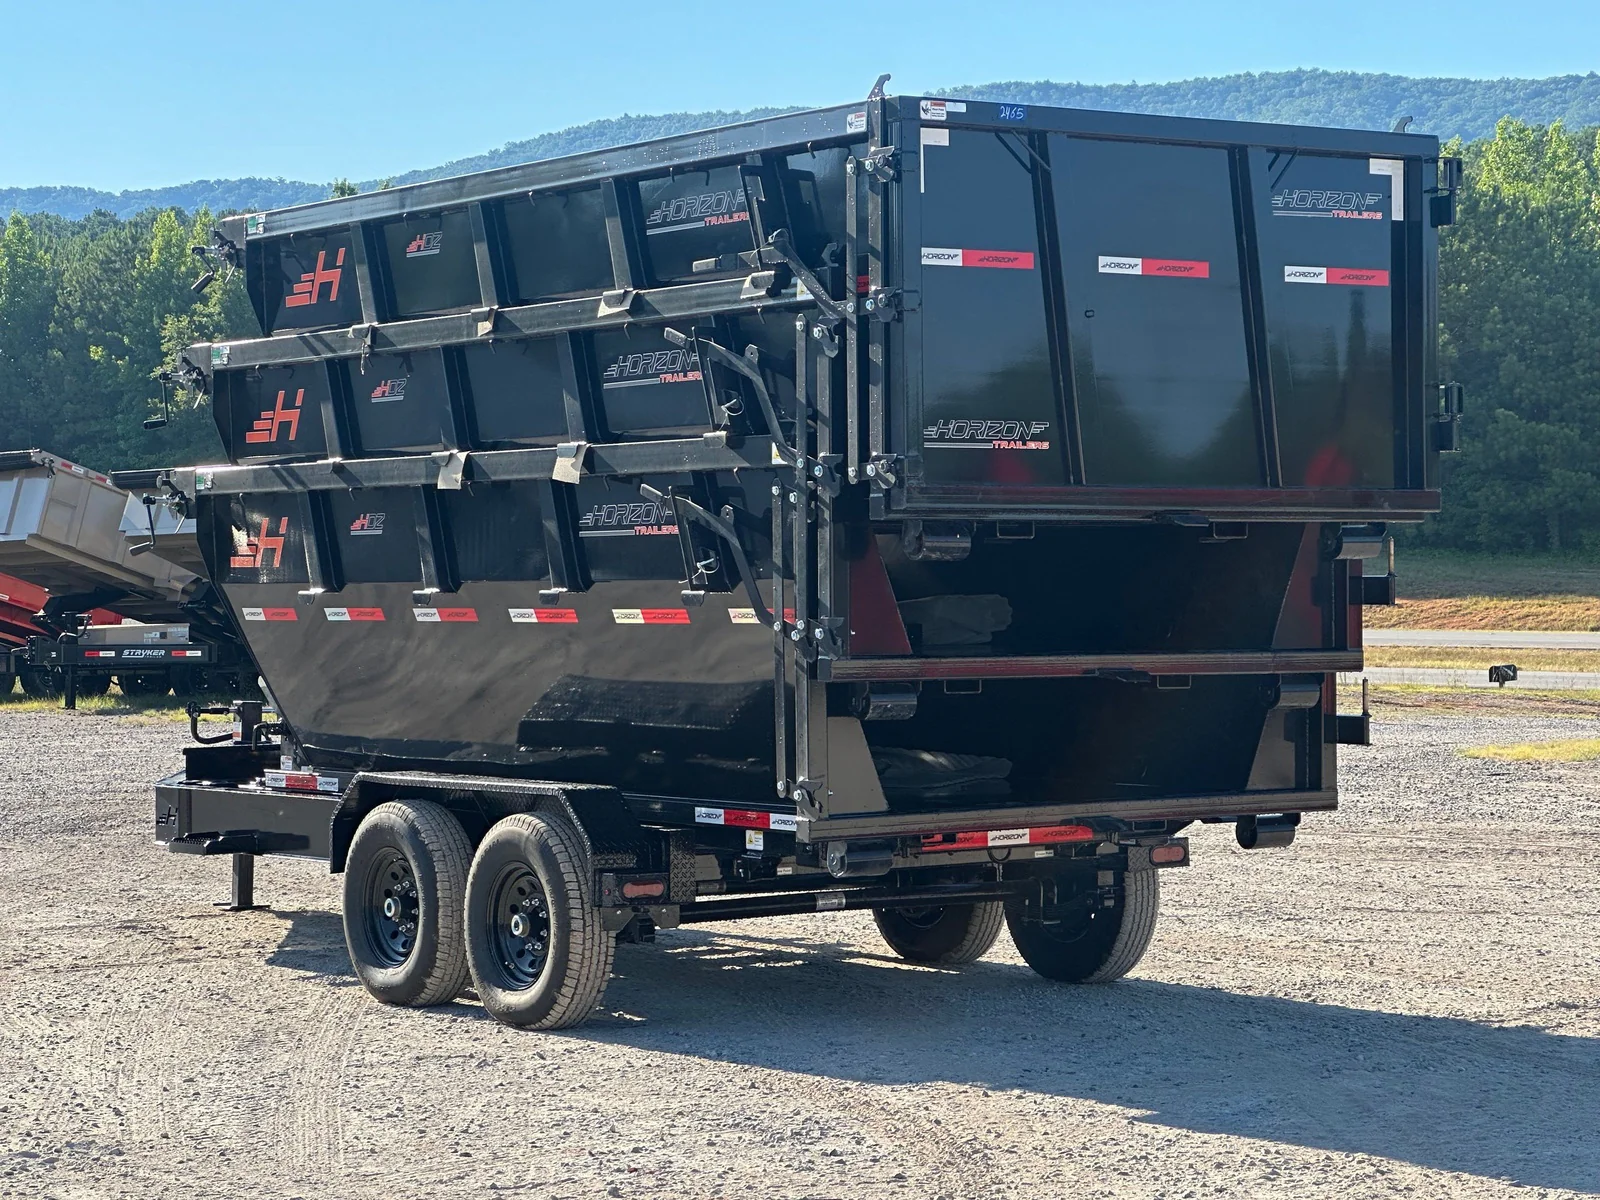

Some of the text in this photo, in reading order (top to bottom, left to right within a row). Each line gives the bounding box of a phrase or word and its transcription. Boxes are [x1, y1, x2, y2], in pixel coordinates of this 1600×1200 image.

[1000, 105, 1024, 120] 2465
[660, 190, 740, 222] HORIZON
[1280, 189, 1369, 211] HORIZON
[1332, 210, 1383, 220] TRAILERS
[922, 252, 1019, 264] HORIZON HORIZON
[1101, 262, 1195, 273] HORIZON HORIZON
[1340, 273, 1376, 281] HORIZON
[617, 349, 692, 377] HORIZON
[935, 419, 1034, 440] HORIZON
[992, 440, 1050, 450] TRAILERS
[592, 502, 667, 526] HORIZON
[122, 649, 165, 658] STRYKER
[990, 833, 1027, 841] HORIZON
